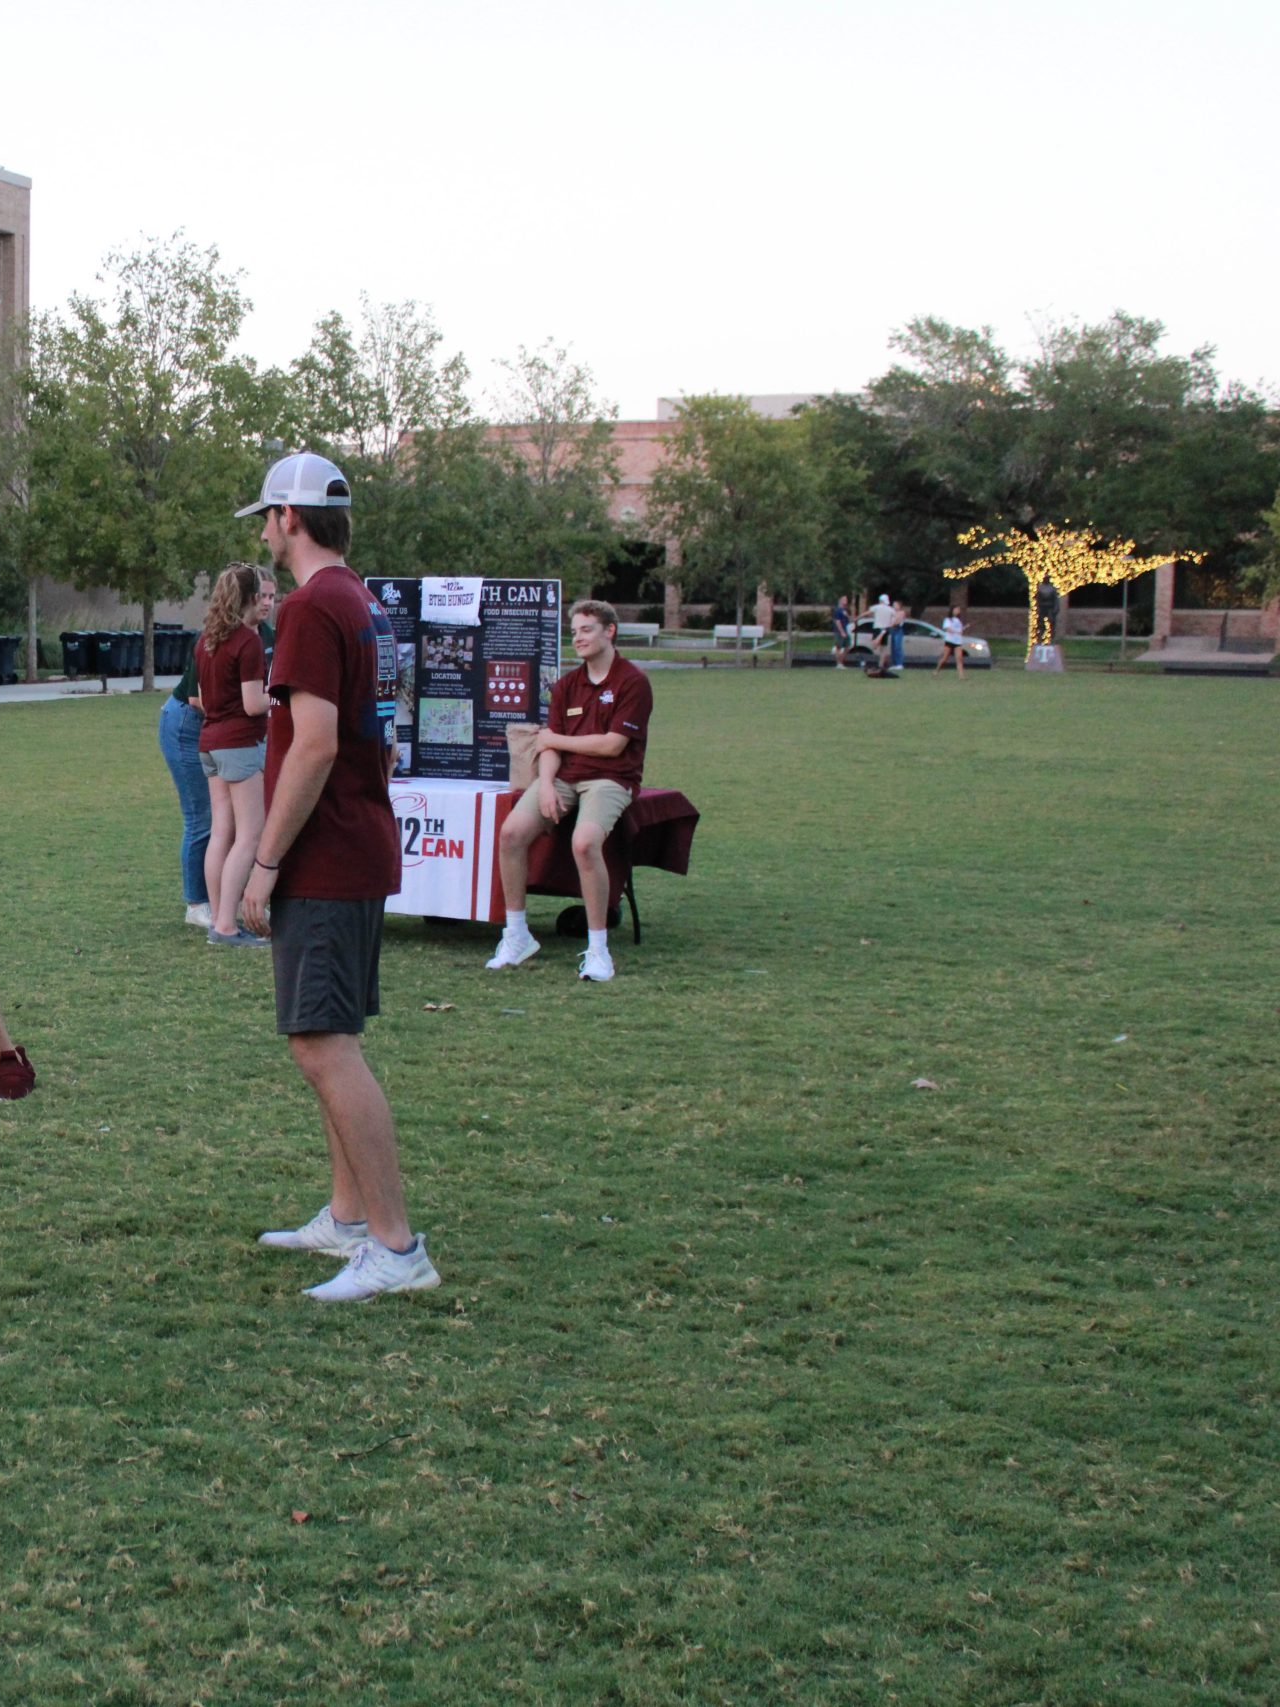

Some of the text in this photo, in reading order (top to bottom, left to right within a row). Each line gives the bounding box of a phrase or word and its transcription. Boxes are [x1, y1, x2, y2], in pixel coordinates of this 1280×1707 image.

[508, 586, 541, 602] CAN
[448, 593, 474, 606] HUNGER
[400, 607, 408, 615] US
[483, 608, 500, 616] FOOD
[501, 608, 539, 616] INSECURITY
[431, 672, 462, 680] LOCATION
[489, 711, 527, 720] DONATIONS
[422, 837, 464, 859] CAN
